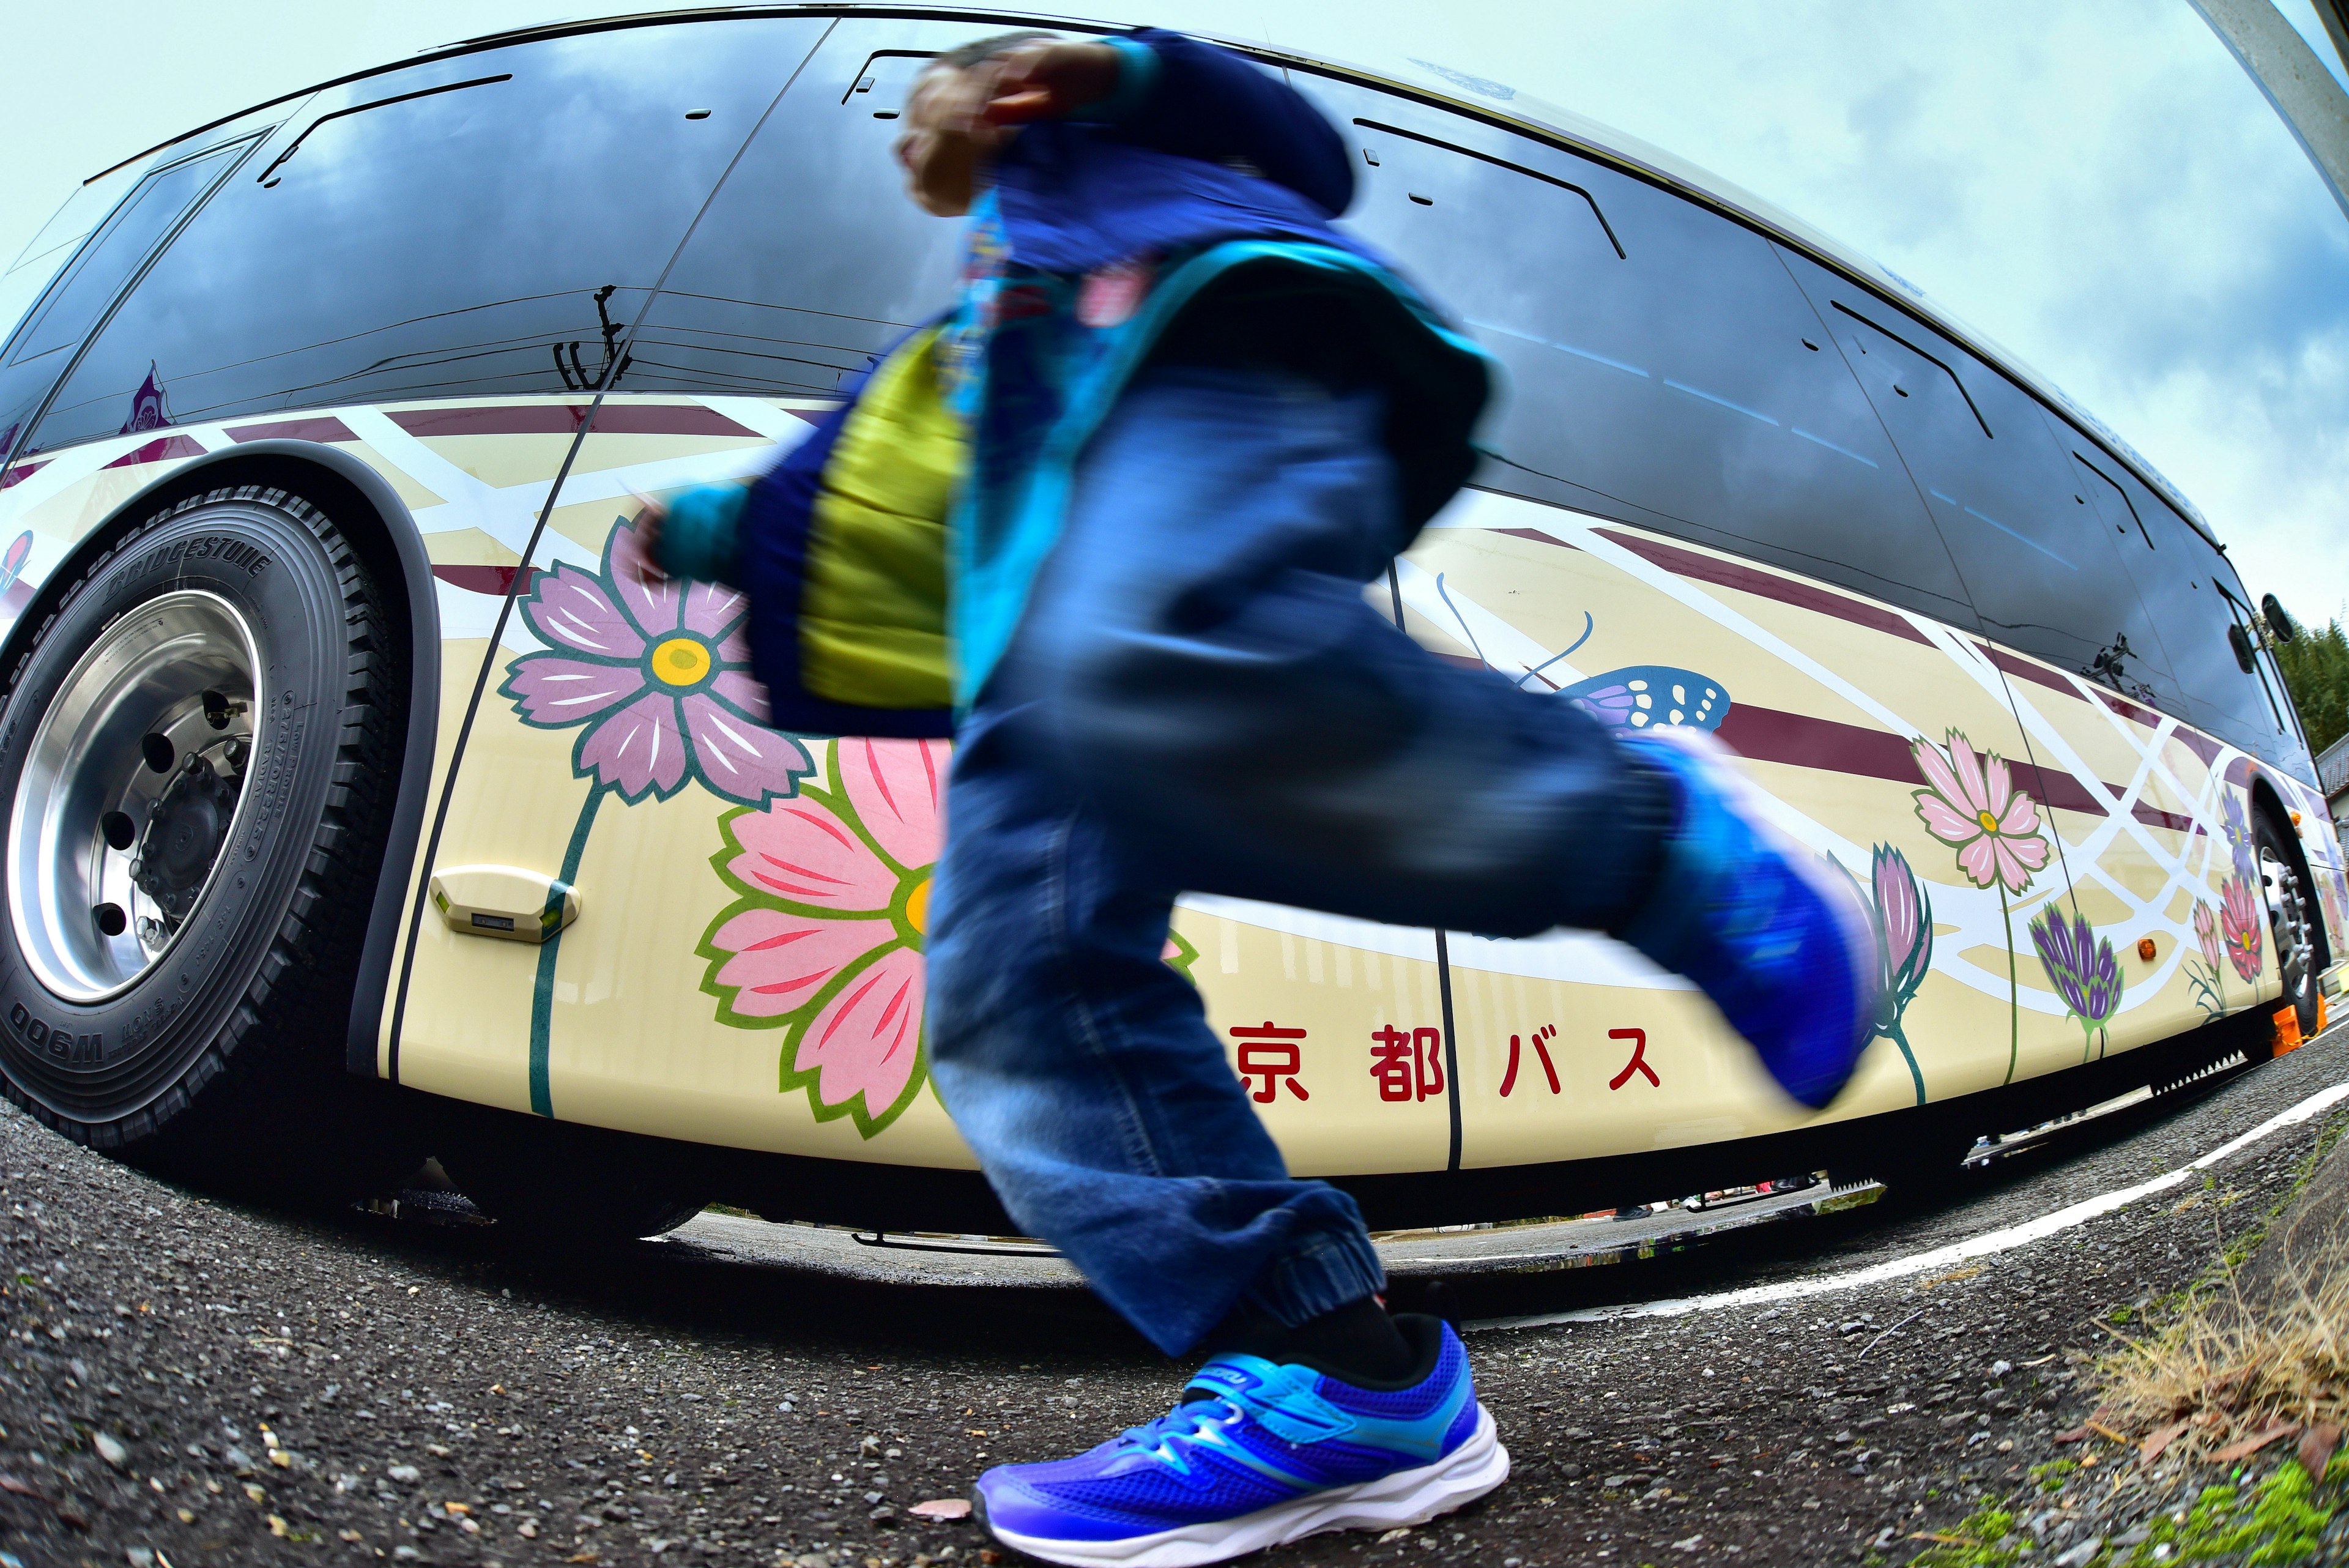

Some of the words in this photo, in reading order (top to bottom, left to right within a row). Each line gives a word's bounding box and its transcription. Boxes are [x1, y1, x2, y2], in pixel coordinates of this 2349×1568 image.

[102, 535, 273, 606] BRIDGESTONE
[253, 741, 273, 801] RADIAL
[253, 707, 292, 841] 275/70R22.5
[9, 1001, 105, 1063] W900
[1229, 1021, 1660, 1103] 京都バス
